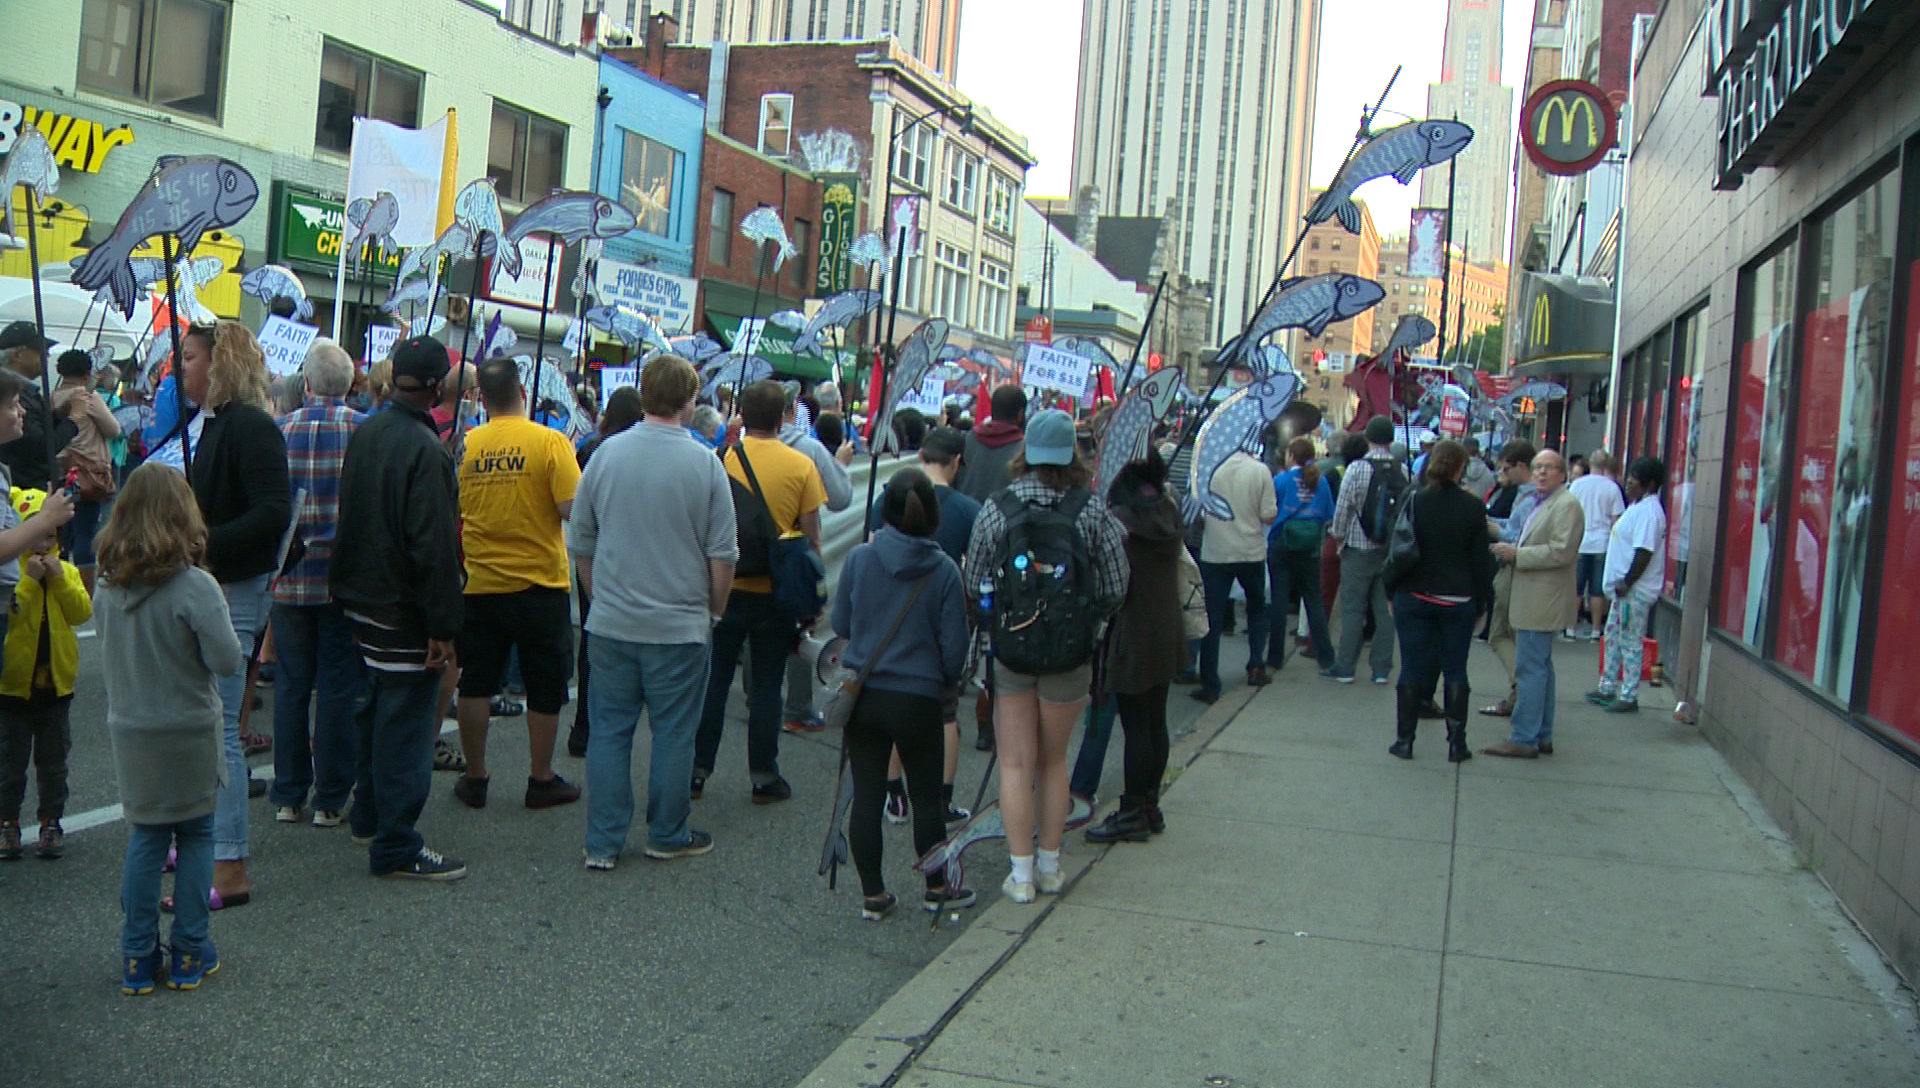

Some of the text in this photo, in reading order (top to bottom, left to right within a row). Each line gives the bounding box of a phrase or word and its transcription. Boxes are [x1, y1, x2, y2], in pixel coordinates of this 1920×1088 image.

[525, 248, 557, 263] OAKLAD
[817, 208, 835, 288] GIDAS
[275, 323, 311, 346] FAITH
[1040, 350, 1079, 369] FAITH
[1028, 364, 1056, 380] FOR
[481, 447, 506, 459] Local
[475, 456, 525, 473] UFCW
